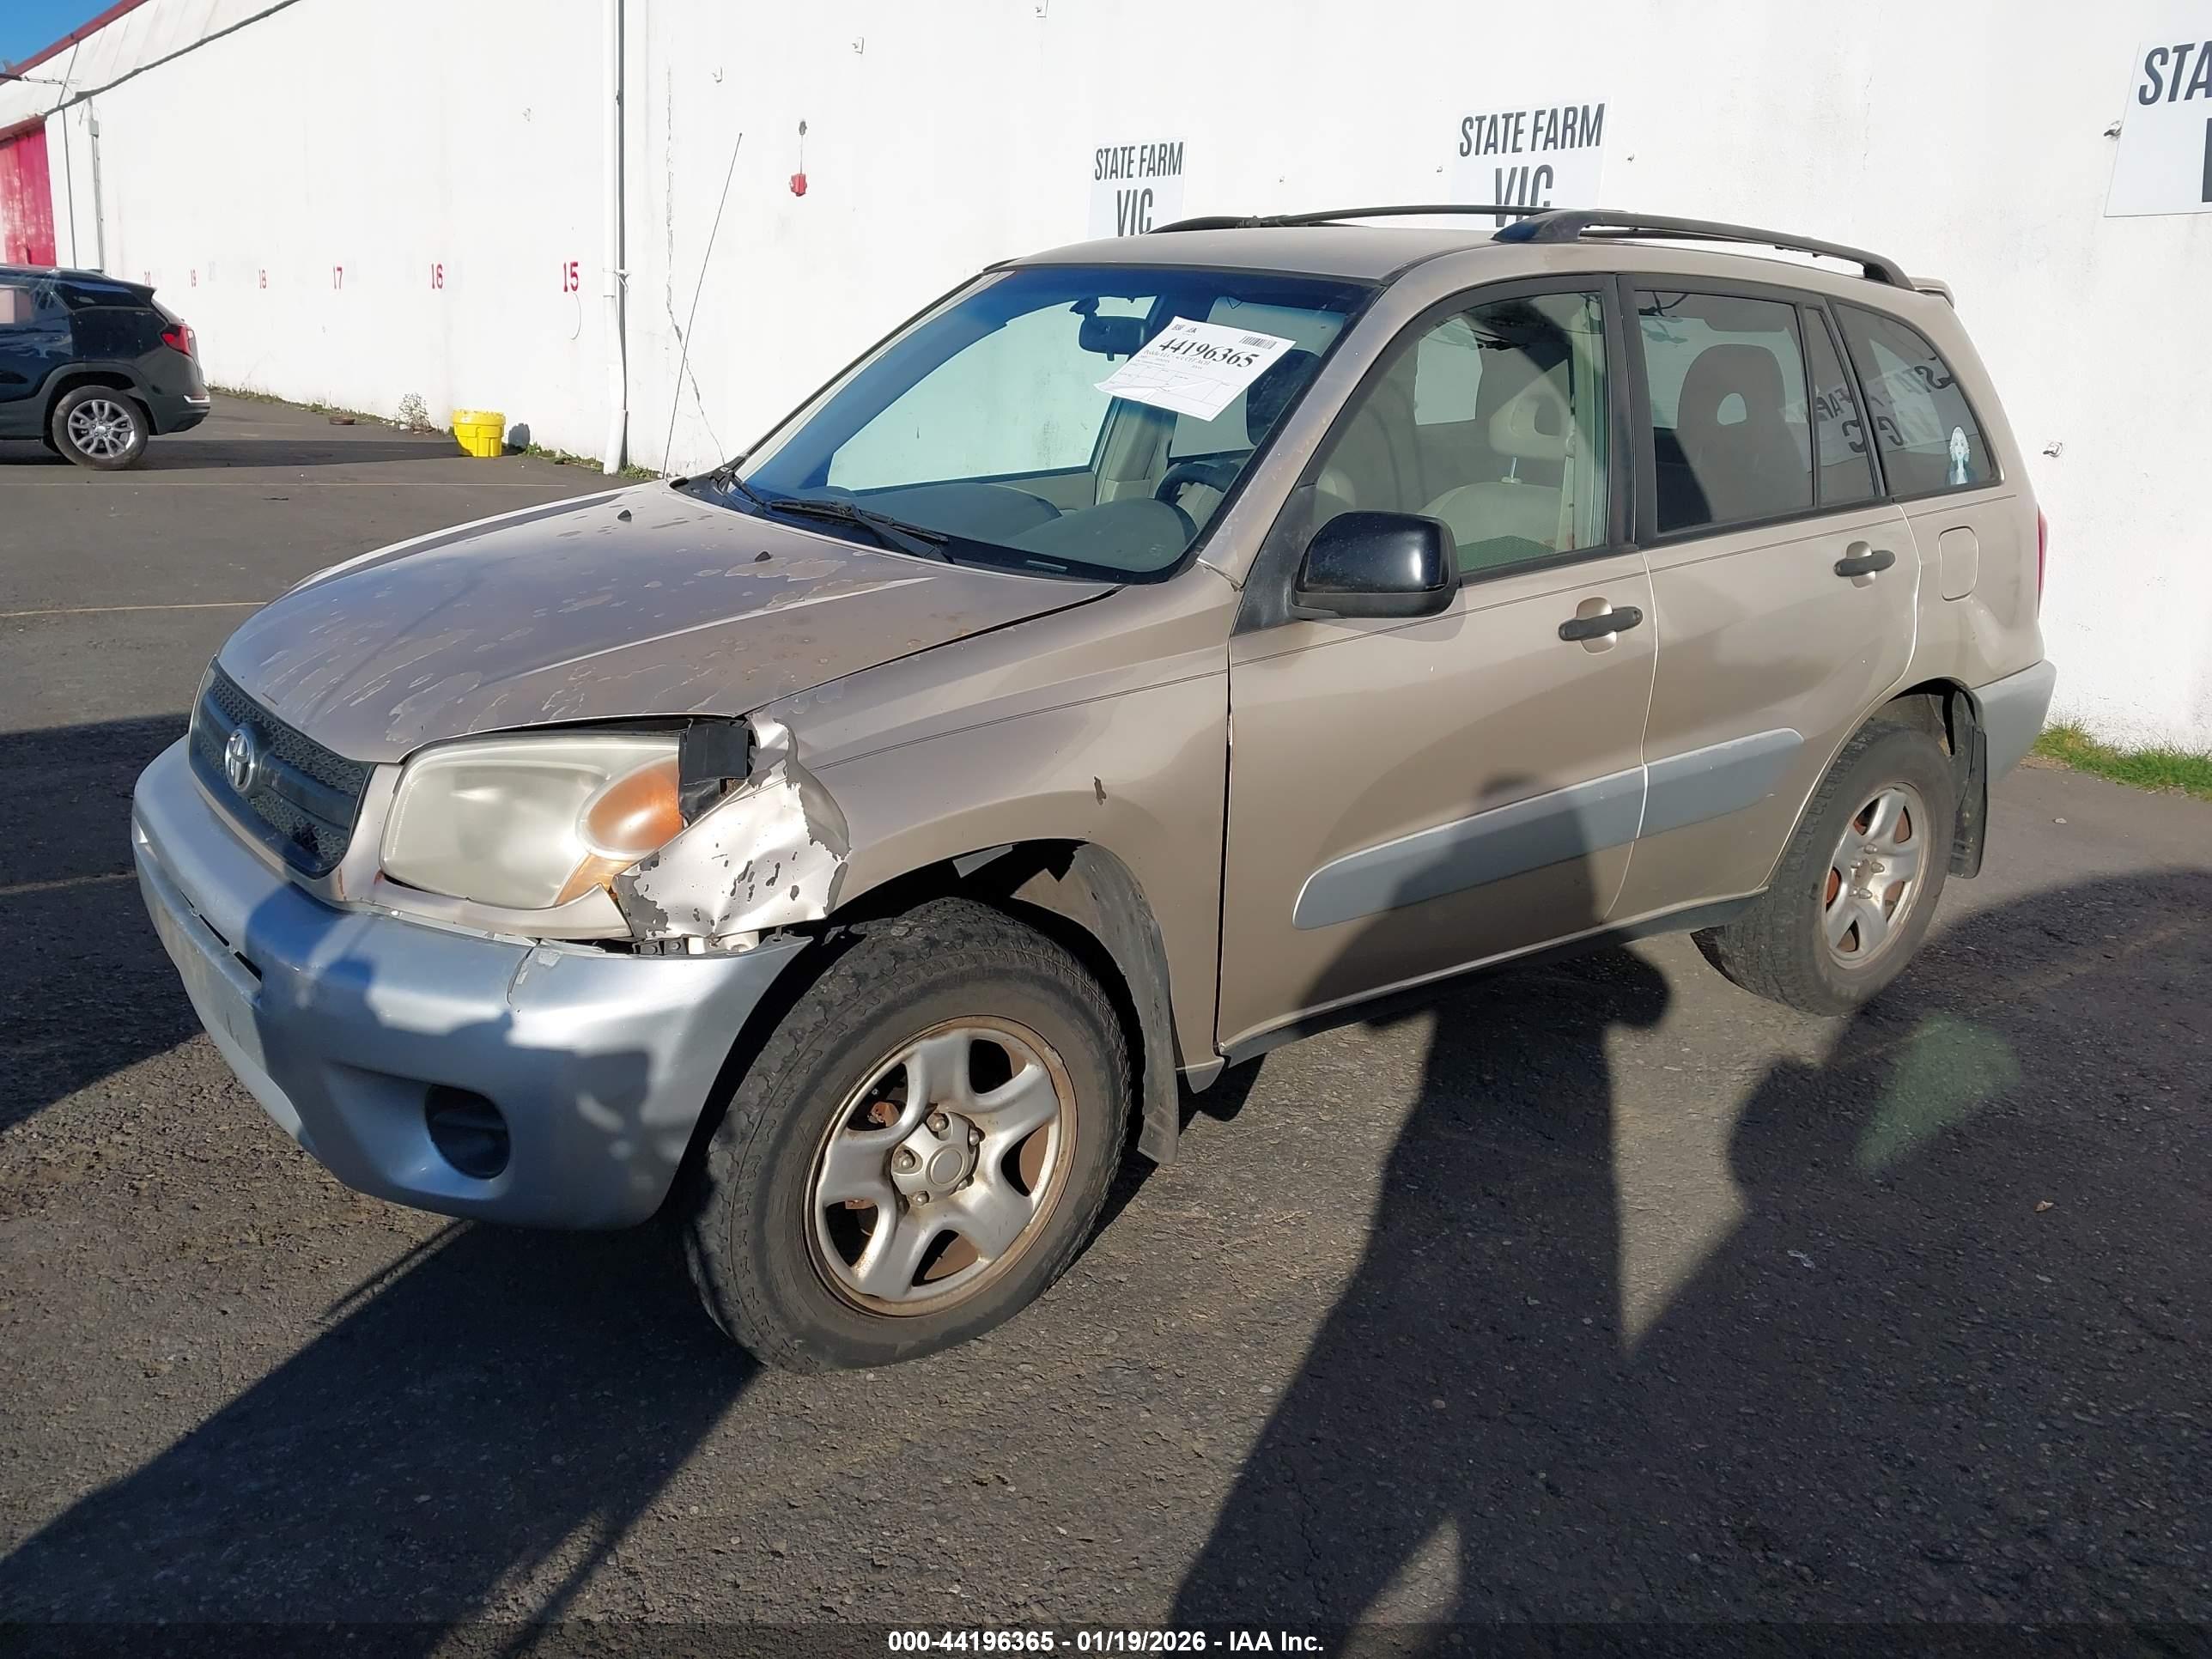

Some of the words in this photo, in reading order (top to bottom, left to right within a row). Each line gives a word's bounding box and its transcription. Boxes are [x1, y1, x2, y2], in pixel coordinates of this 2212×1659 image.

[1459, 111, 1527, 157] STATE
[1530, 103, 1605, 152] FARM
[1094, 145, 1136, 180] STATE
[1139, 142, 1183, 178] FARM
[1495, 164, 1554, 228] VIC
[1116, 188, 1153, 237] VIC
[190, 269, 197, 288] 19
[258, 269, 267, 289] 18
[332, 266, 343, 290] 17
[431, 263, 444, 289] 16
[562, 261, 580, 293] 15
[1159, 337, 1260, 368] 44196365
